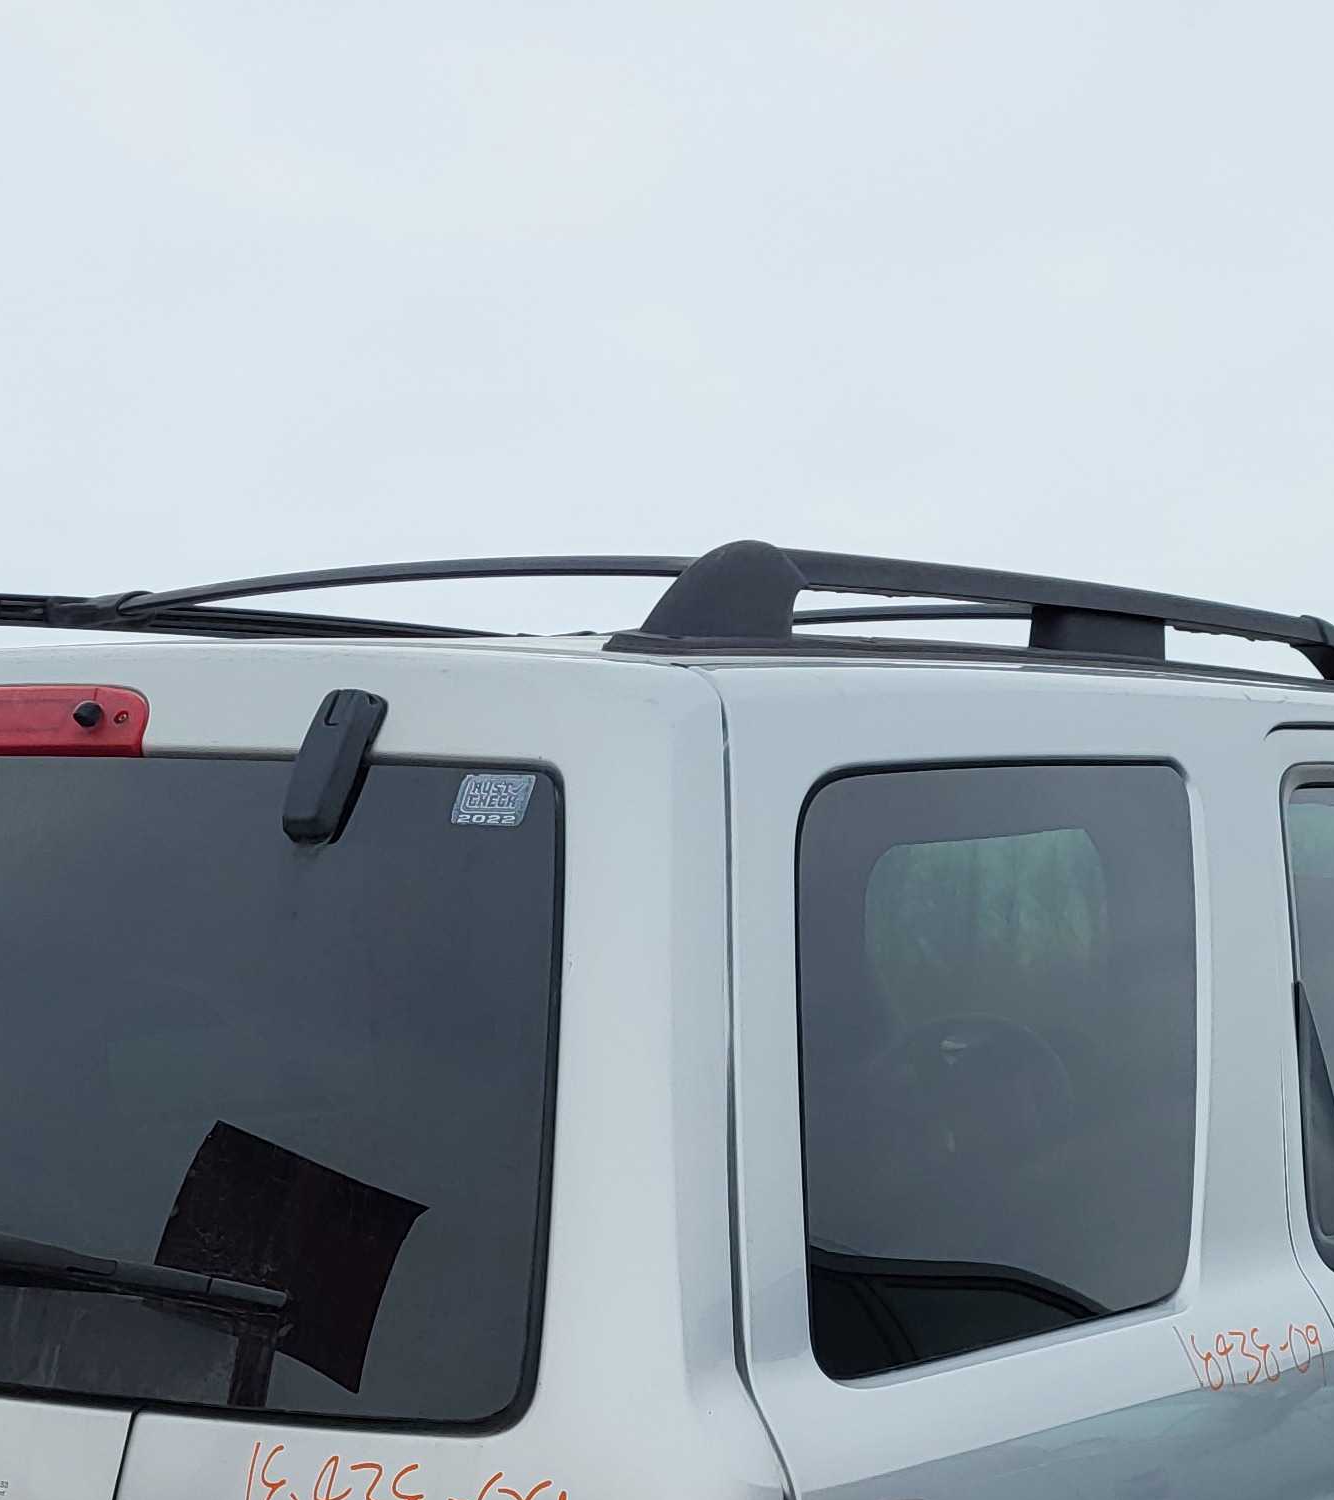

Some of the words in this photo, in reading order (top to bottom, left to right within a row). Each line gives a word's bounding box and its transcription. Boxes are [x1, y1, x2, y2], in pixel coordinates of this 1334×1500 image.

[467, 781, 507, 795] RUST
[466, 795, 516, 808] CHECK
[457, 814, 516, 824] 2022
